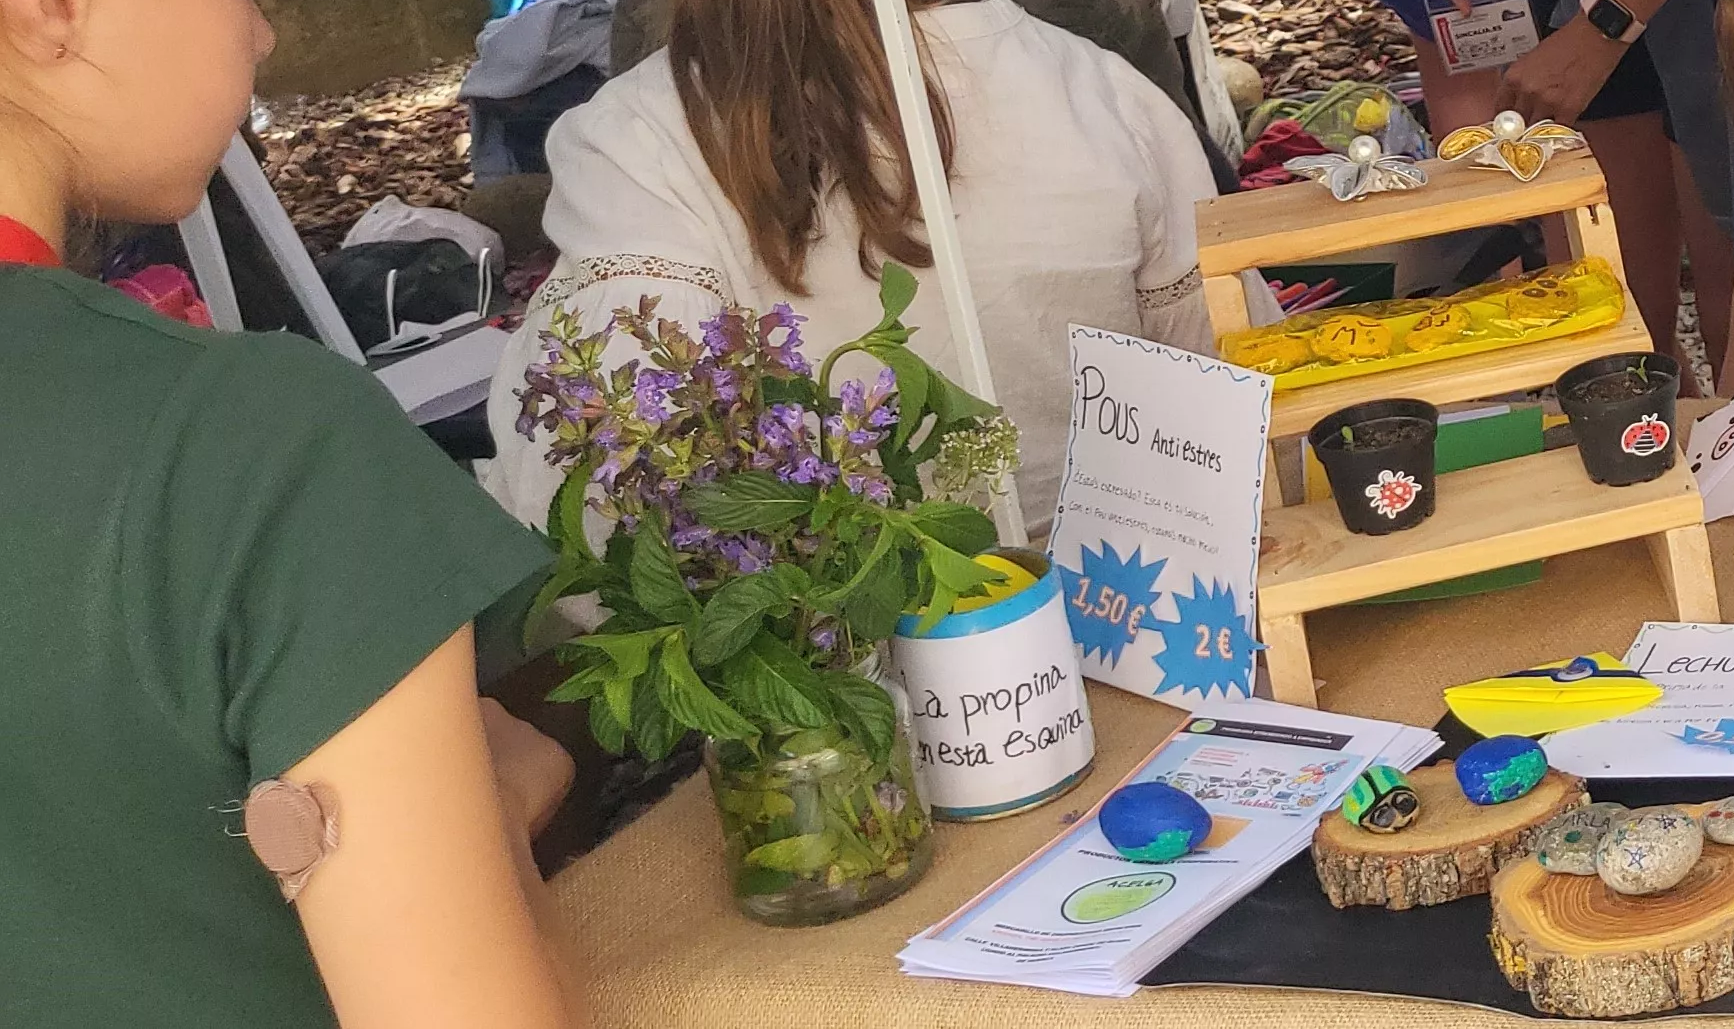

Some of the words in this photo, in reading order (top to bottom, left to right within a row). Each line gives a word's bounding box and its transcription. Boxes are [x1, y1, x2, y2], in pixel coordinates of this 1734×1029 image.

[1071, 577, 1129, 626] 1,50
[1127, 606, 1147, 637] €
[1195, 624, 1211, 659] 2
[1217, 627, 1234, 661] €
[960, 665, 1067, 737] propina
[938, 741, 995, 768] esta
